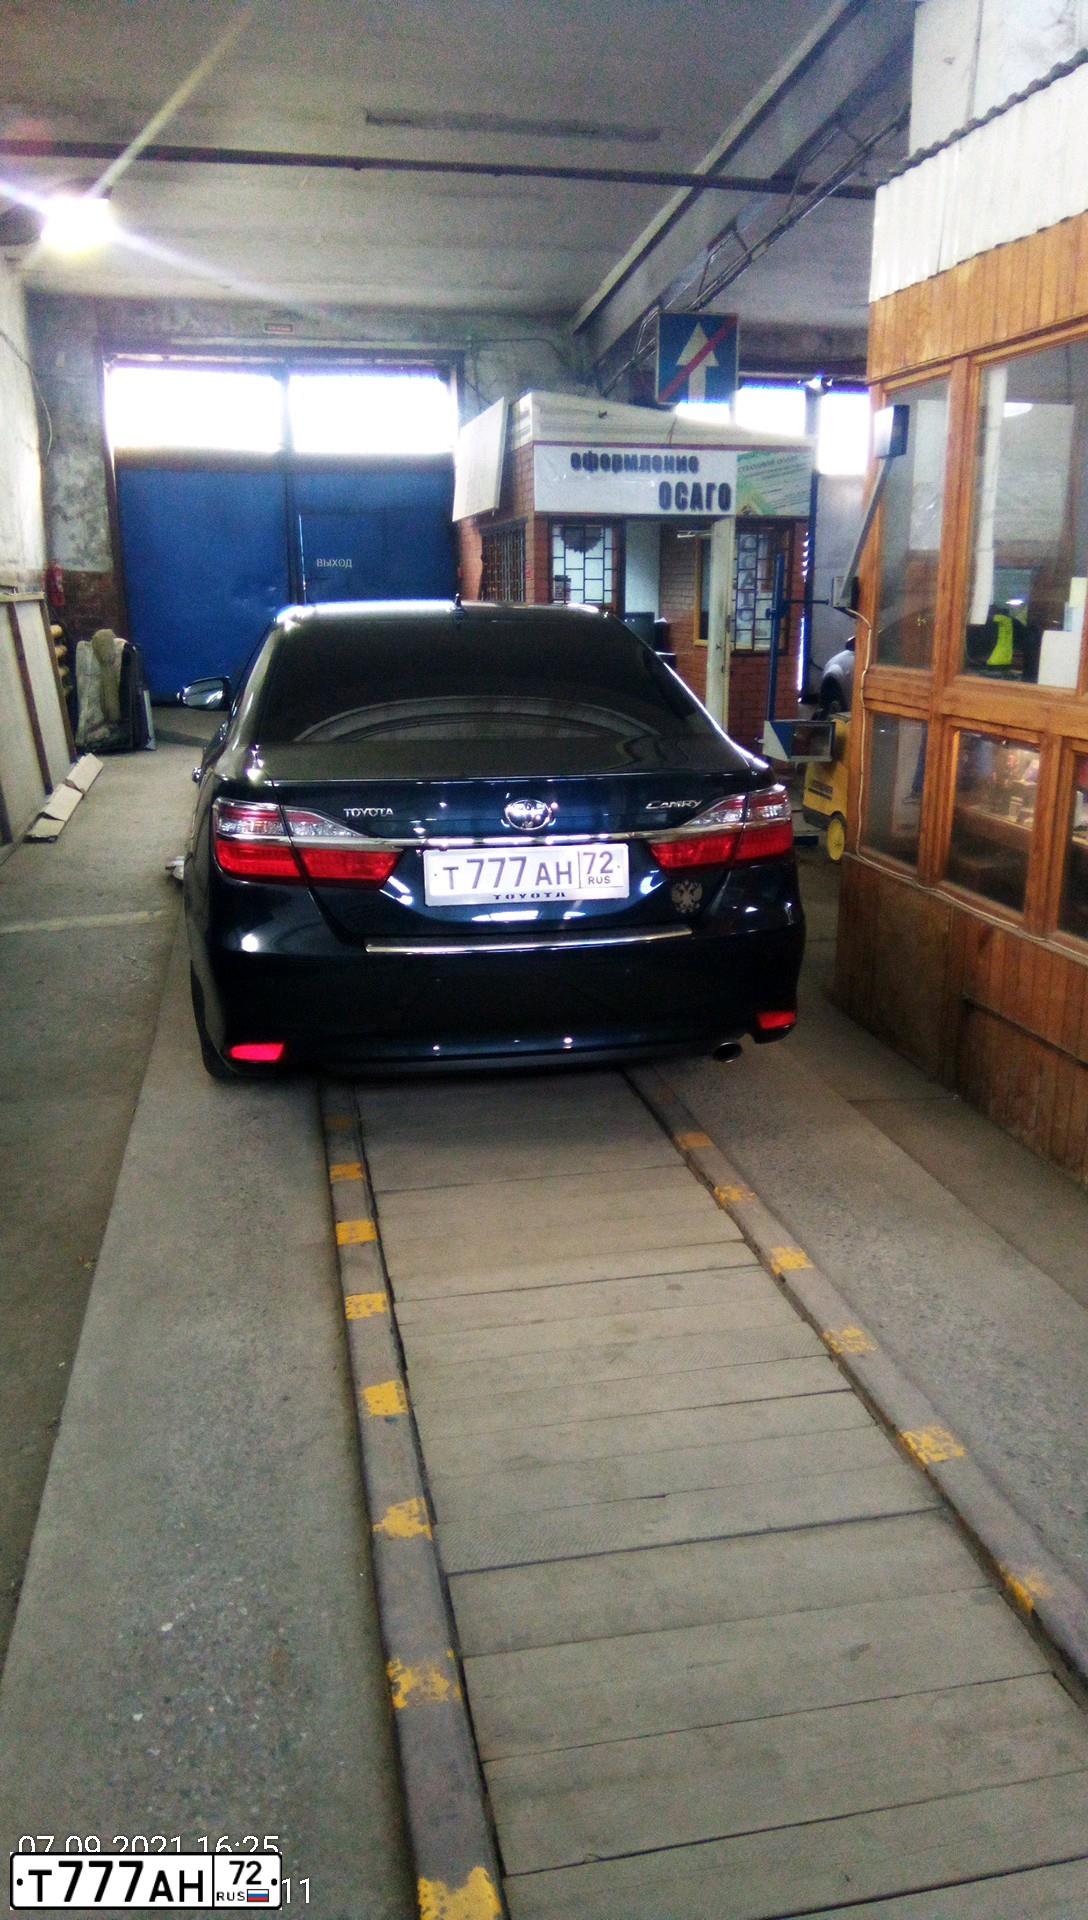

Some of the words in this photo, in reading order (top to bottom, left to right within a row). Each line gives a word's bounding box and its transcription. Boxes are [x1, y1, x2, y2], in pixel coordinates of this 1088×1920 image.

[658, 481, 731, 511] ОСАГО
[316, 558, 353, 568] ВЫХОД
[343, 808, 394, 817] TOYOTA
[583, 851, 614, 874] 72
[588, 876, 611, 885] RUS
[493, 892, 567, 900] TOYOTA
